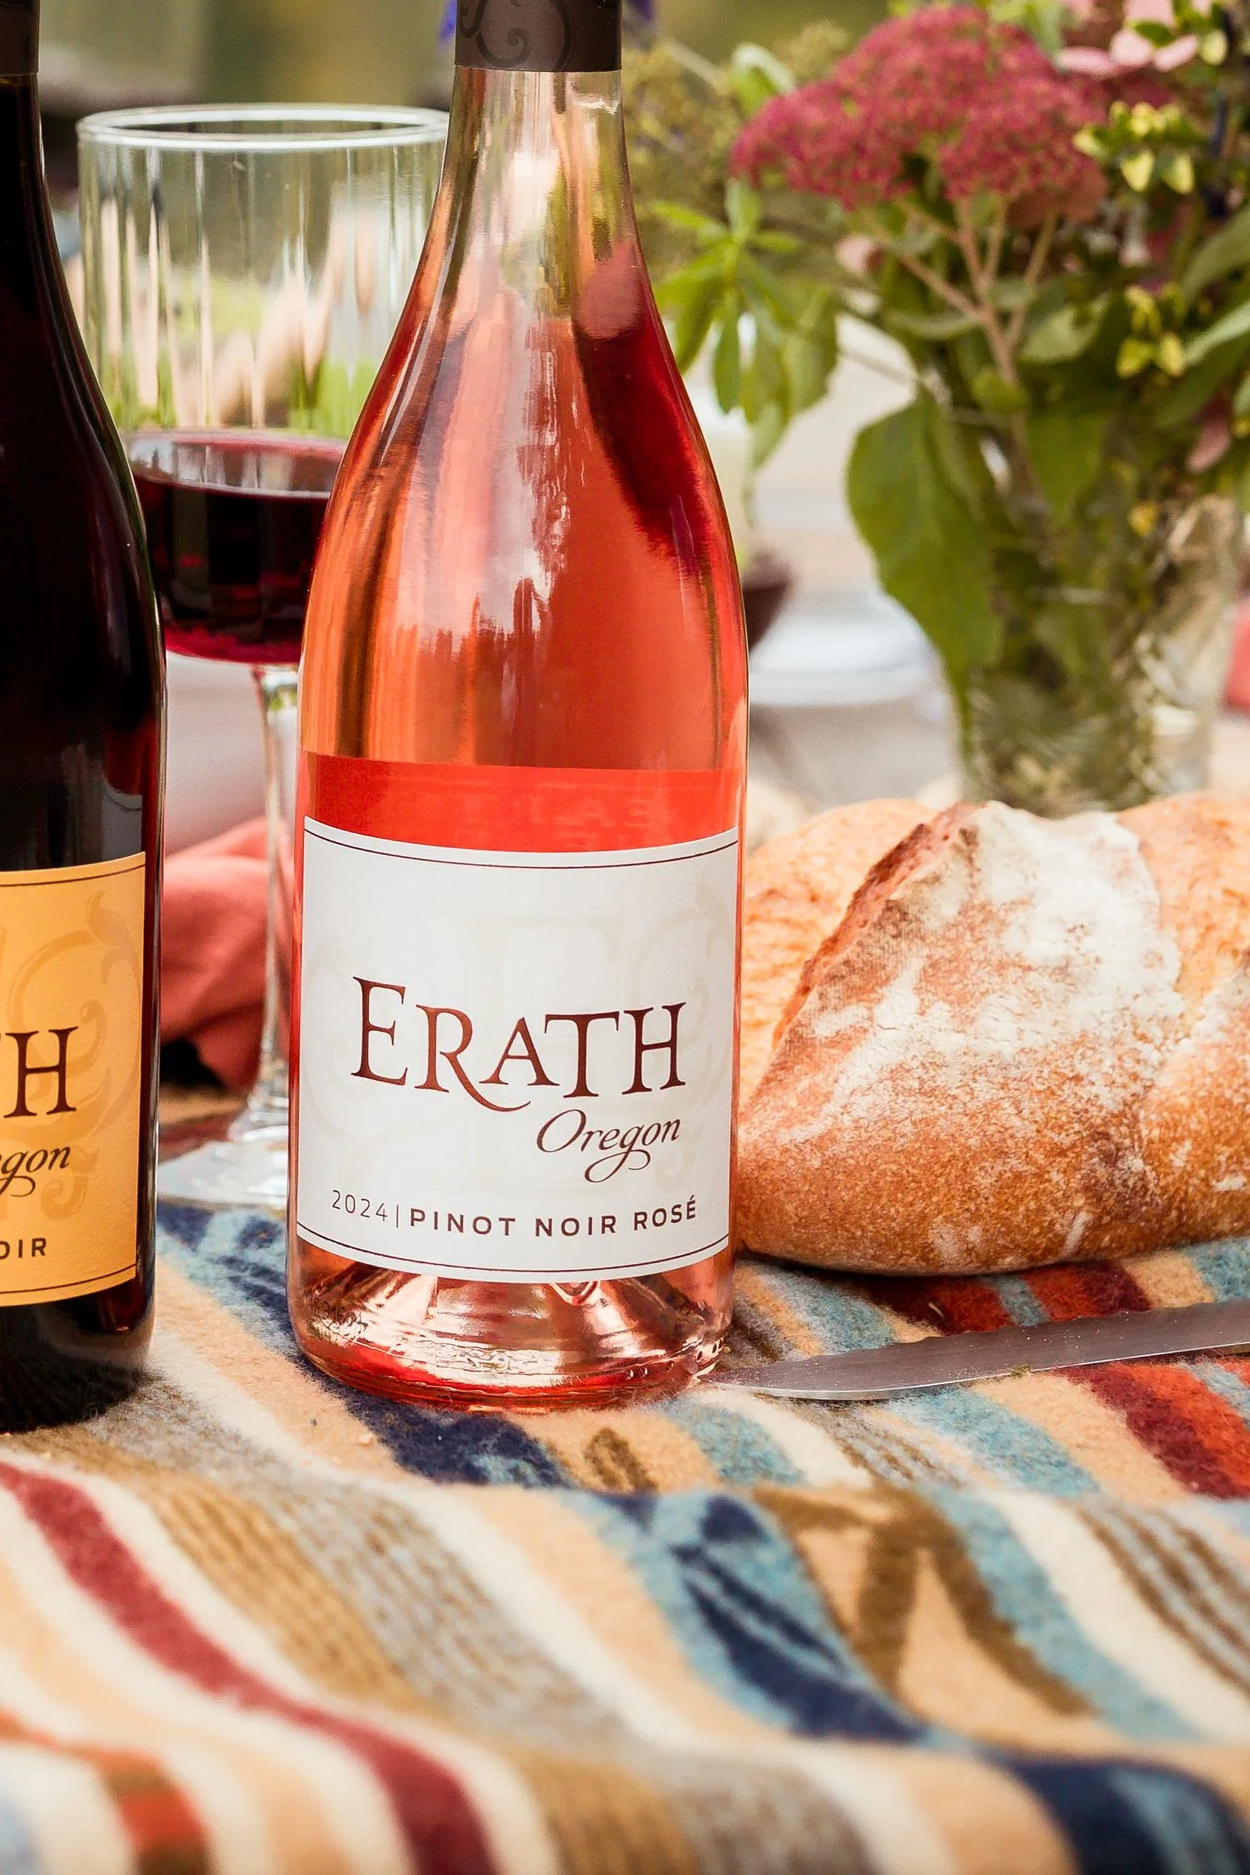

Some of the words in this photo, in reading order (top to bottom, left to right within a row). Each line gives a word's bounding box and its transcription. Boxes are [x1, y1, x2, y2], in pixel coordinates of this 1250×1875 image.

[350, 976, 686, 1112] ERATH
[536, 1109, 681, 1183] Oregon
[331, 1190, 389, 1223] 2024
[410, 1208, 516, 1237] PINOT
[535, 1215, 616, 1237] NOIR
[633, 1194, 697, 1230] ROSÉ
